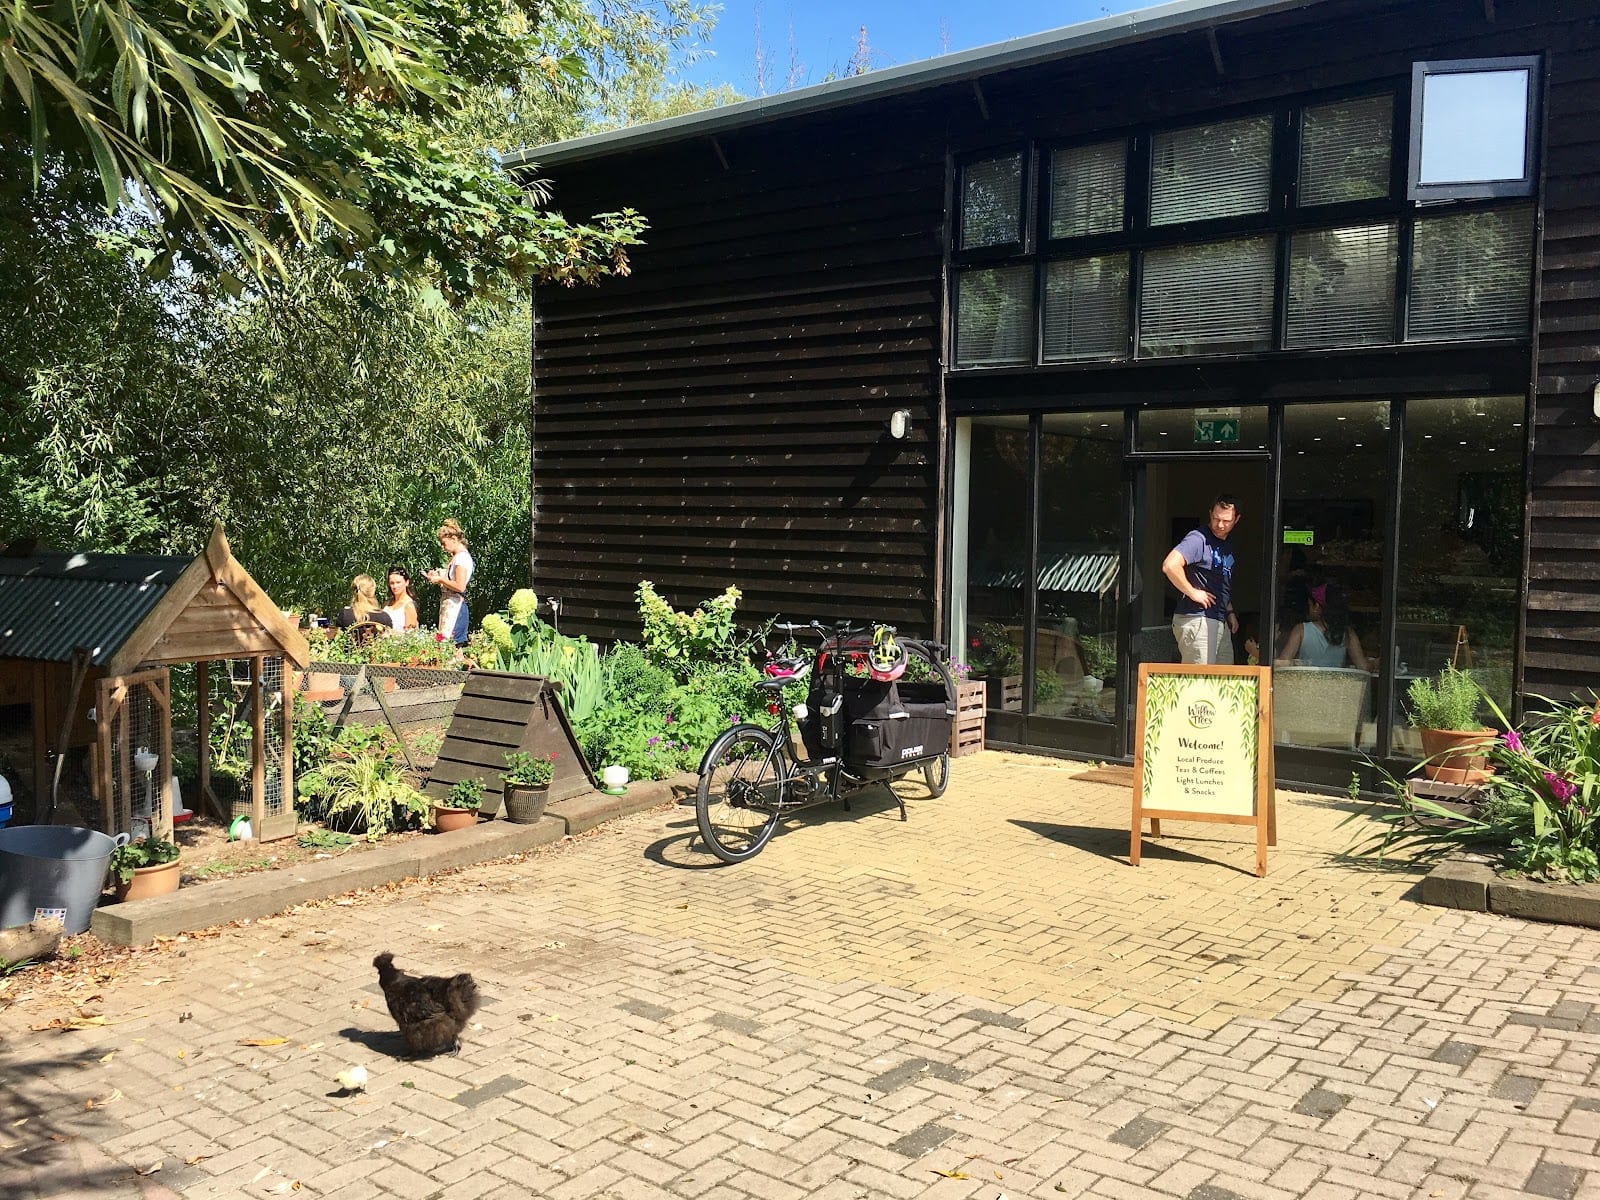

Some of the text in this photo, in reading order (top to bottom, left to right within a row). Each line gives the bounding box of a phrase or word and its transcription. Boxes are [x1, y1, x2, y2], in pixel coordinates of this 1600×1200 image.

[1191, 715, 1213, 724] Trees
[1178, 737, 1224, 750] Welcome!
[1177, 755, 1224, 765] Local Produce
[1175, 765, 1226, 775] Teas & Coffees
[1176, 776, 1224, 786] Light Lunches
[1191, 787, 1216, 796] Snacks
